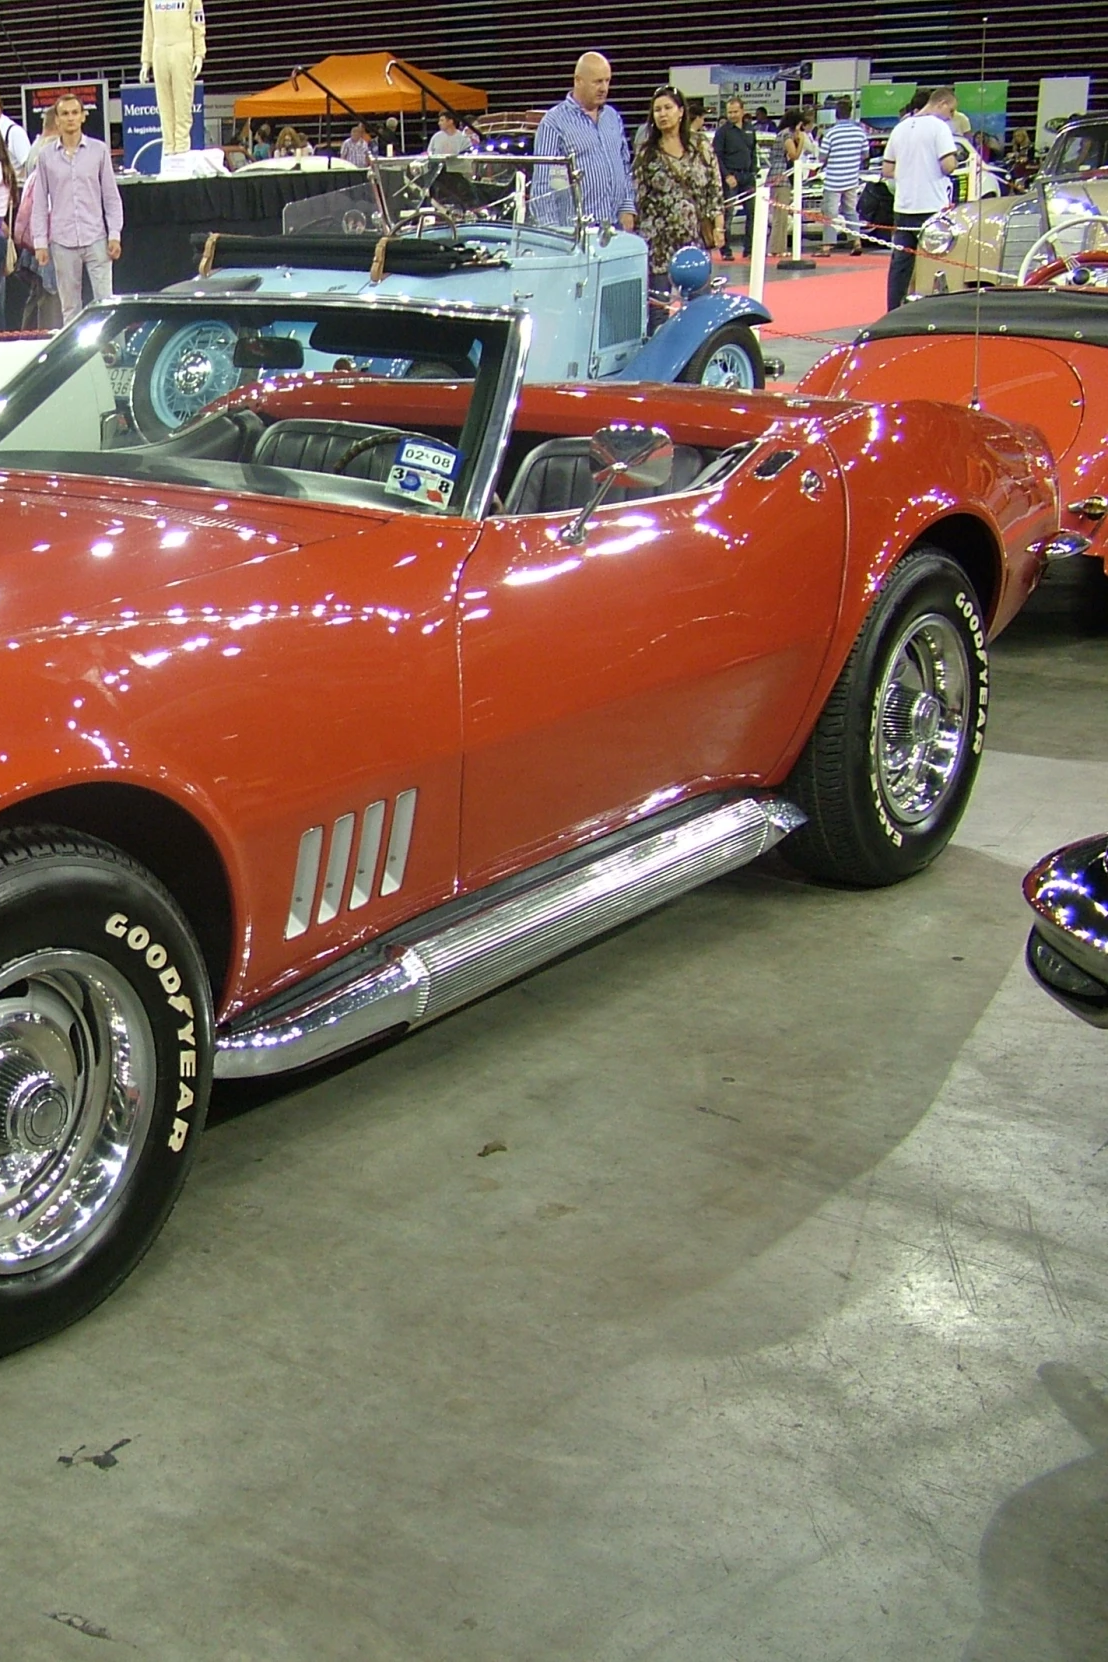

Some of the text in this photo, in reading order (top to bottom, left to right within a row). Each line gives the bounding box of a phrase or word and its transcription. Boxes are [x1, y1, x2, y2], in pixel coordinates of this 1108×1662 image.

[393, 467, 450, 493] 3 8
[955, 591, 991, 756] GOODYEAR
[105, 911, 198, 1154] GOODYEAR
